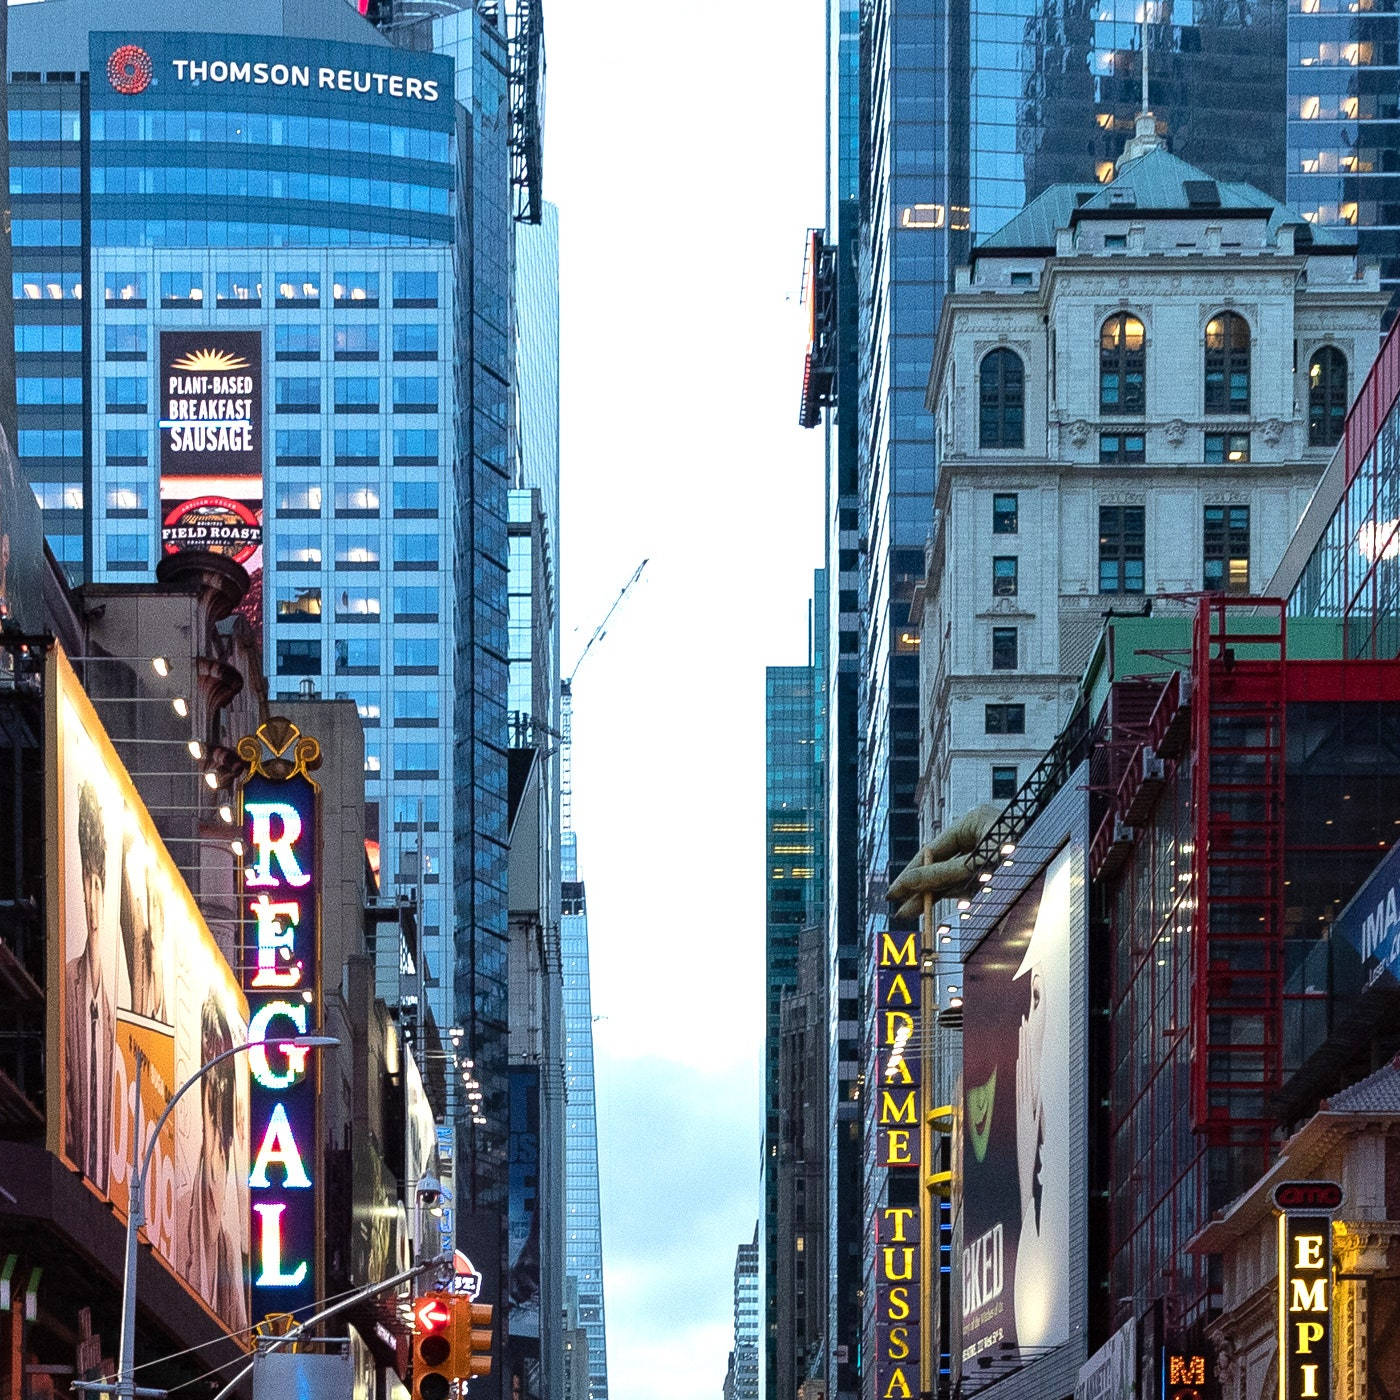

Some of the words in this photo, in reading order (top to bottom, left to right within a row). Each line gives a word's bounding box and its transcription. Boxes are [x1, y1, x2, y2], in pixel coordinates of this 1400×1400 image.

[173, 60, 310, 88] THOMSON
[318, 68, 439, 101] REUTERS
[169, 376, 253, 395] PLANT-BASED
[169, 399, 253, 421] BREAKFAST
[170, 425, 254, 452] SAUSAGE
[162, 528, 207, 540] FIELD
[211, 527, 261, 540] ROAST
[244, 801, 312, 1288] REGAL
[879, 933, 918, 1164] MADAME
[962, 1223, 1004, 1318] CKED
